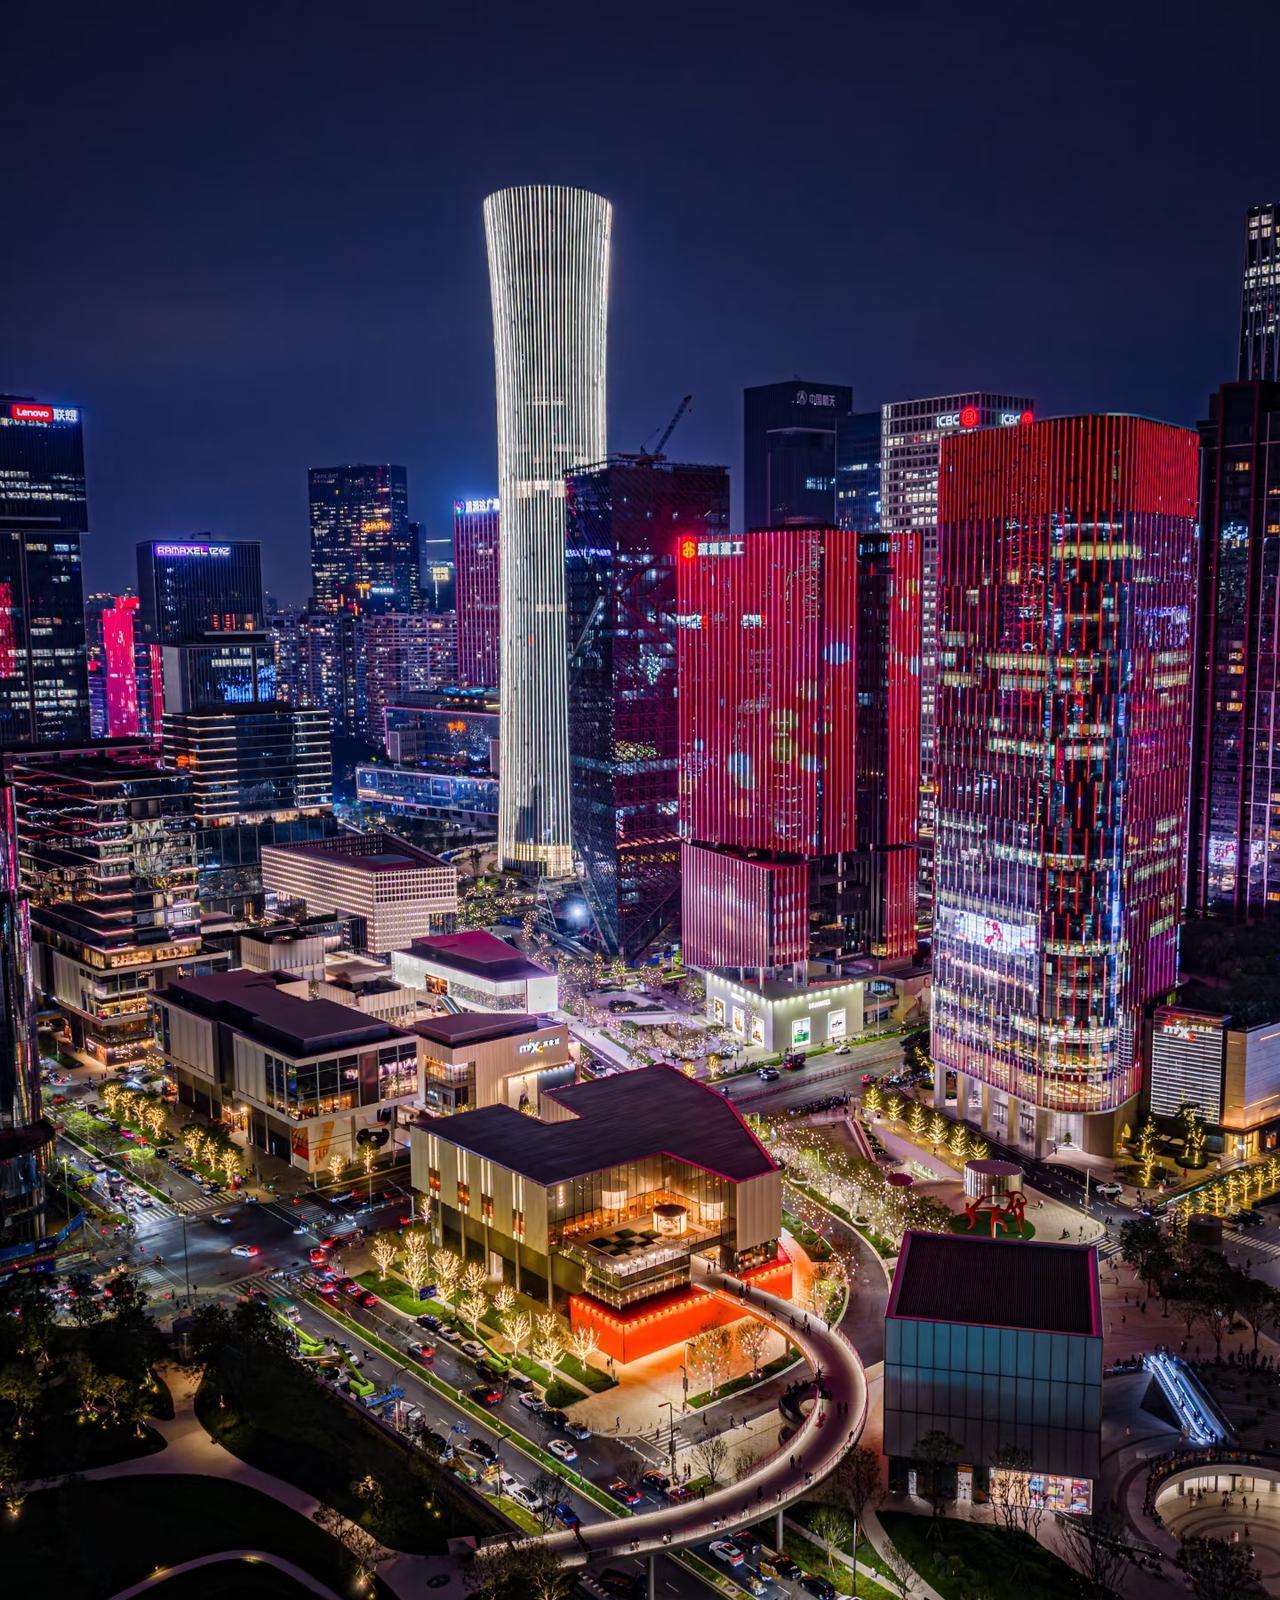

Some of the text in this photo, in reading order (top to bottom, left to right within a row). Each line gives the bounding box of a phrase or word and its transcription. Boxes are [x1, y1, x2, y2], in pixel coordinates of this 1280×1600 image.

[16, 408, 78, 423] Lenovo 联想
[936, 414, 960, 428] ICBC
[157, 545, 208, 555] RAMAXEL
